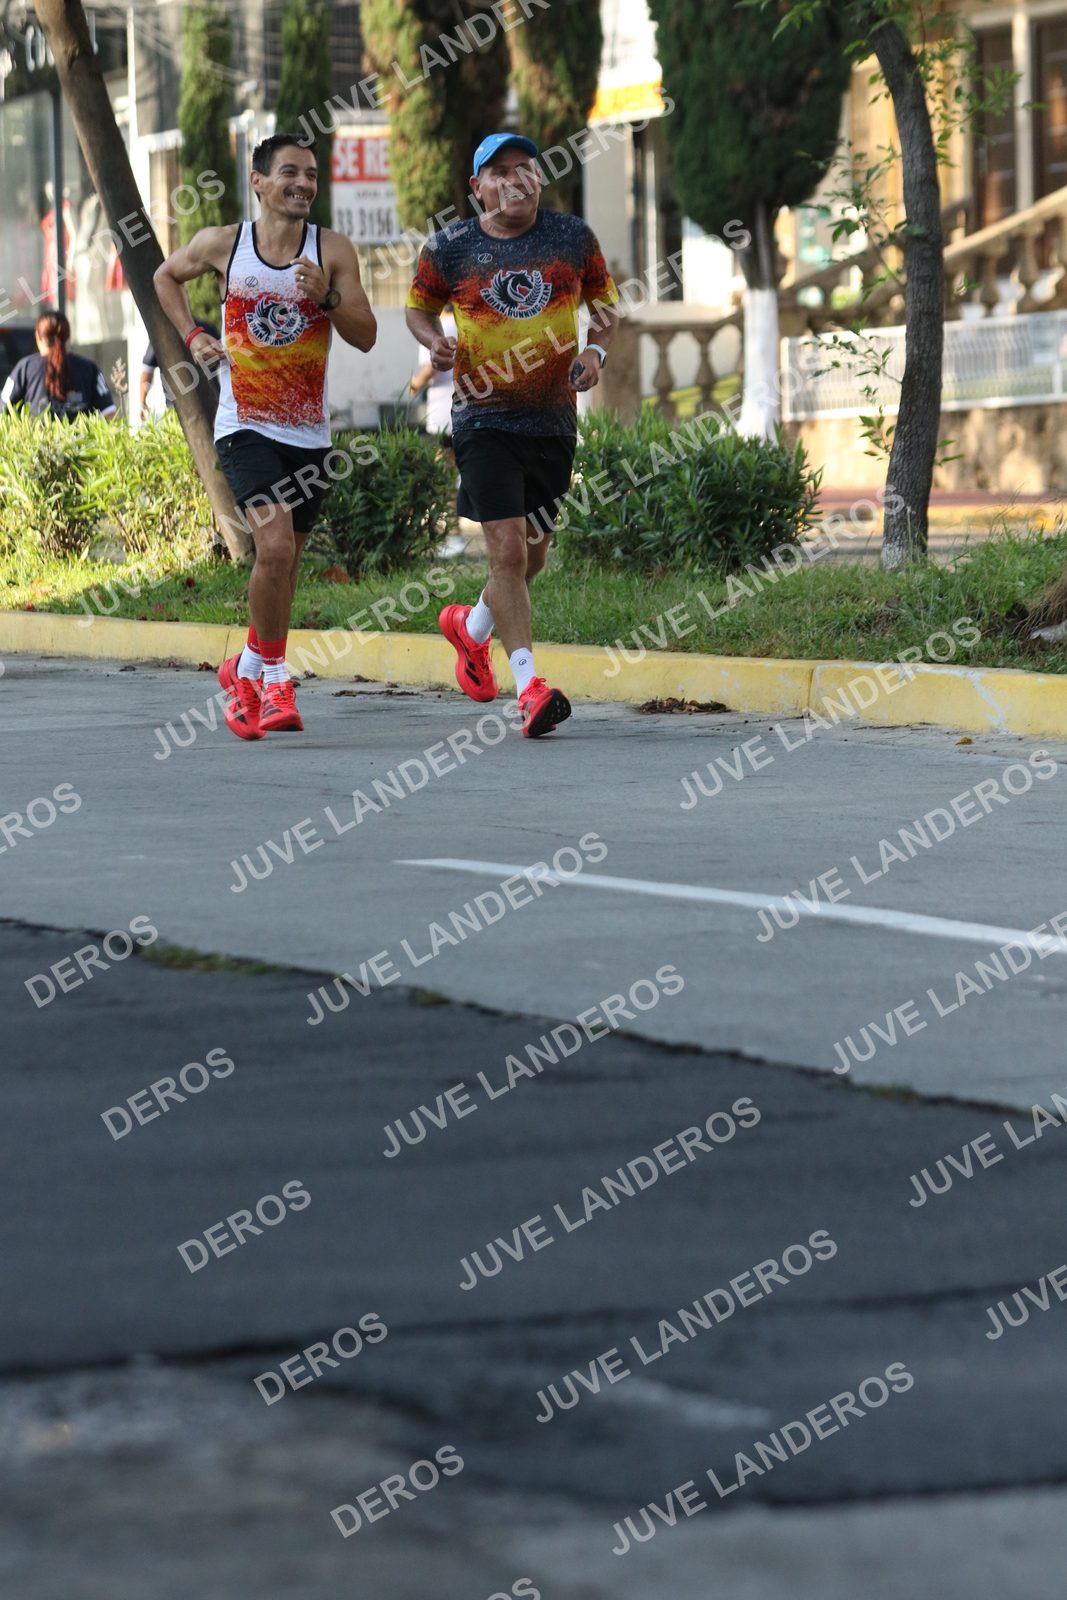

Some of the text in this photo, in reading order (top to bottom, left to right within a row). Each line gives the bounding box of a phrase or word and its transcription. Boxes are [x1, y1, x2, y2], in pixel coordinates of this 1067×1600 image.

[333, 138, 359, 177] SE
[508, 305, 542, 318] RUNNING
[538, 284, 551, 306] TEAM
